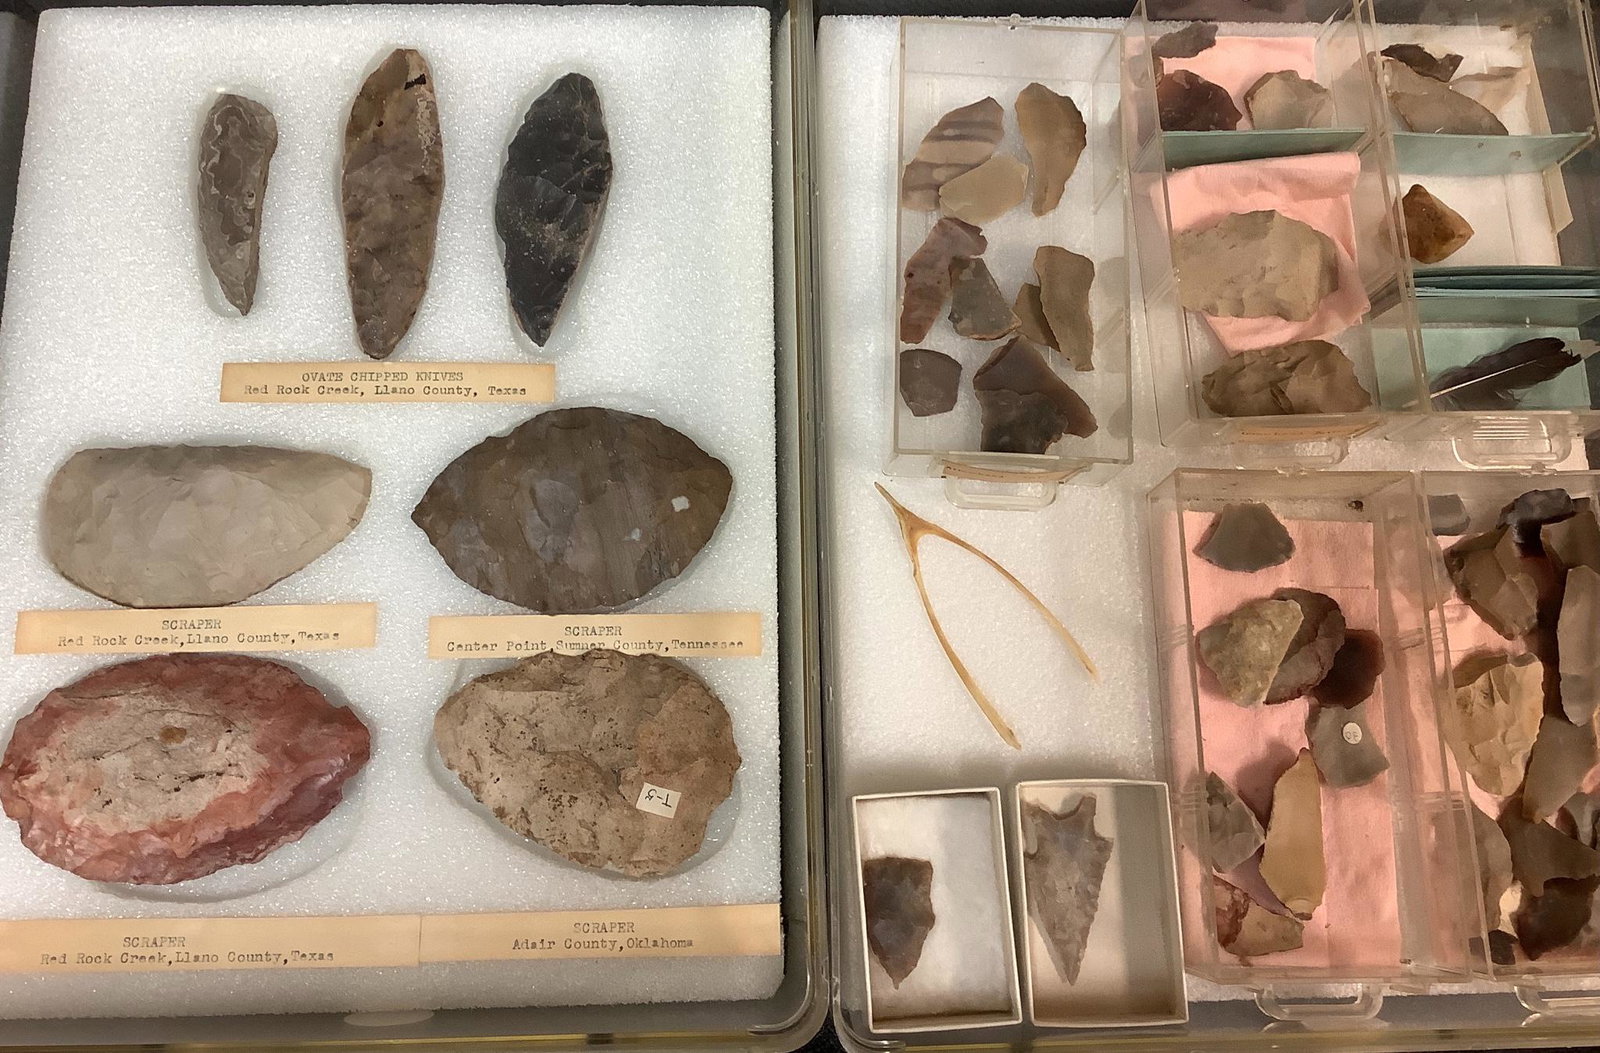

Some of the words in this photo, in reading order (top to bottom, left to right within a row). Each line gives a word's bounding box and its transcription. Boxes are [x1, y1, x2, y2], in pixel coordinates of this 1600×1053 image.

[302, 372, 343, 382] OVATE
[350, 372, 408, 382] CHIPPED
[416, 371, 464, 382] KNIVES
[244, 385, 269, 395] Red
[276, 385, 310, 395] Rock
[317, 385, 364, 397] Creek,
[374, 385, 415, 395] Llano
[423, 385, 478, 397] County,
[488, 386, 527, 396] Texas
[161, 619, 221, 630] SCRAPER
[564, 626, 622, 636] SCRAPER
[58, 635, 84, 647] Red
[93, 635, 127, 646] Rock
[447, 641, 498, 652] Center
[573, 922, 635, 934] SCRAPER
[122, 936, 186, 948] SCRAPER
[512, 938, 556, 950] Adair
[40, 953, 67, 965] Red
[76, 952, 113, 964] Rock
